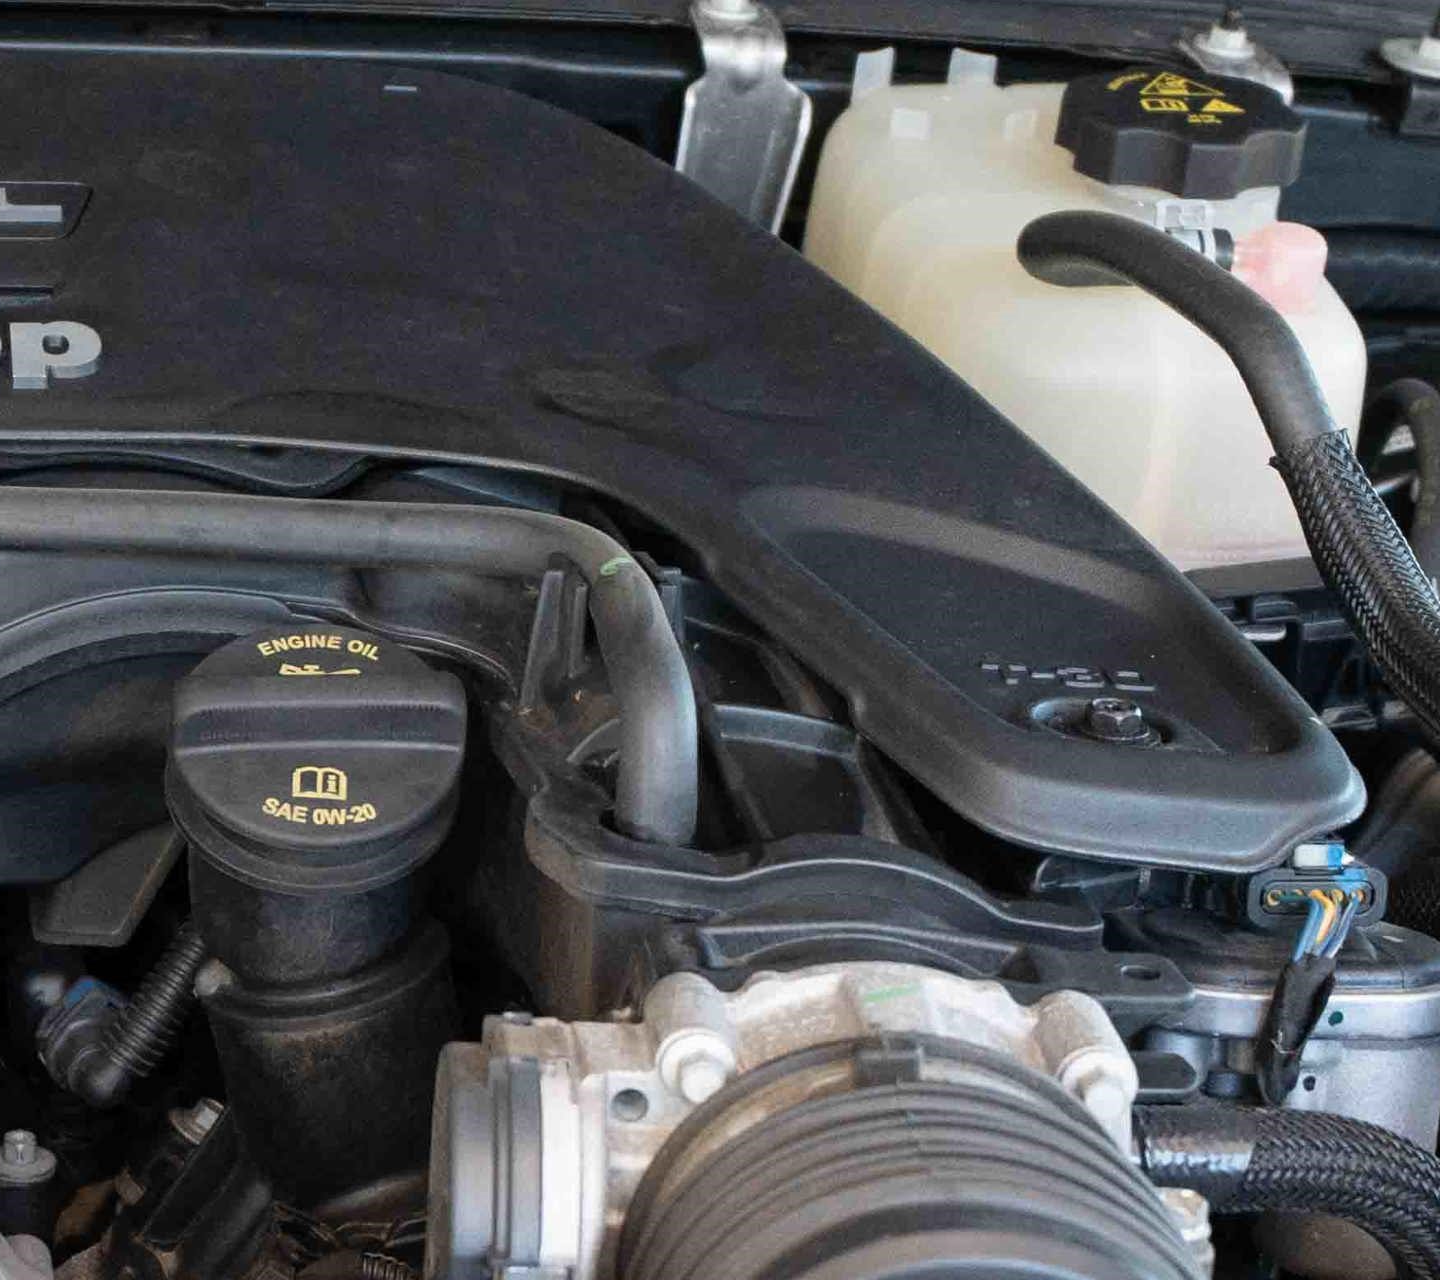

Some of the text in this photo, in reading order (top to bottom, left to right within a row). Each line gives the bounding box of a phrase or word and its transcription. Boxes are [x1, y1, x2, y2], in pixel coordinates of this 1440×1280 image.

[257, 634, 380, 661] ENGINE OIL
[262, 797, 377, 825] SAE 0W-20
